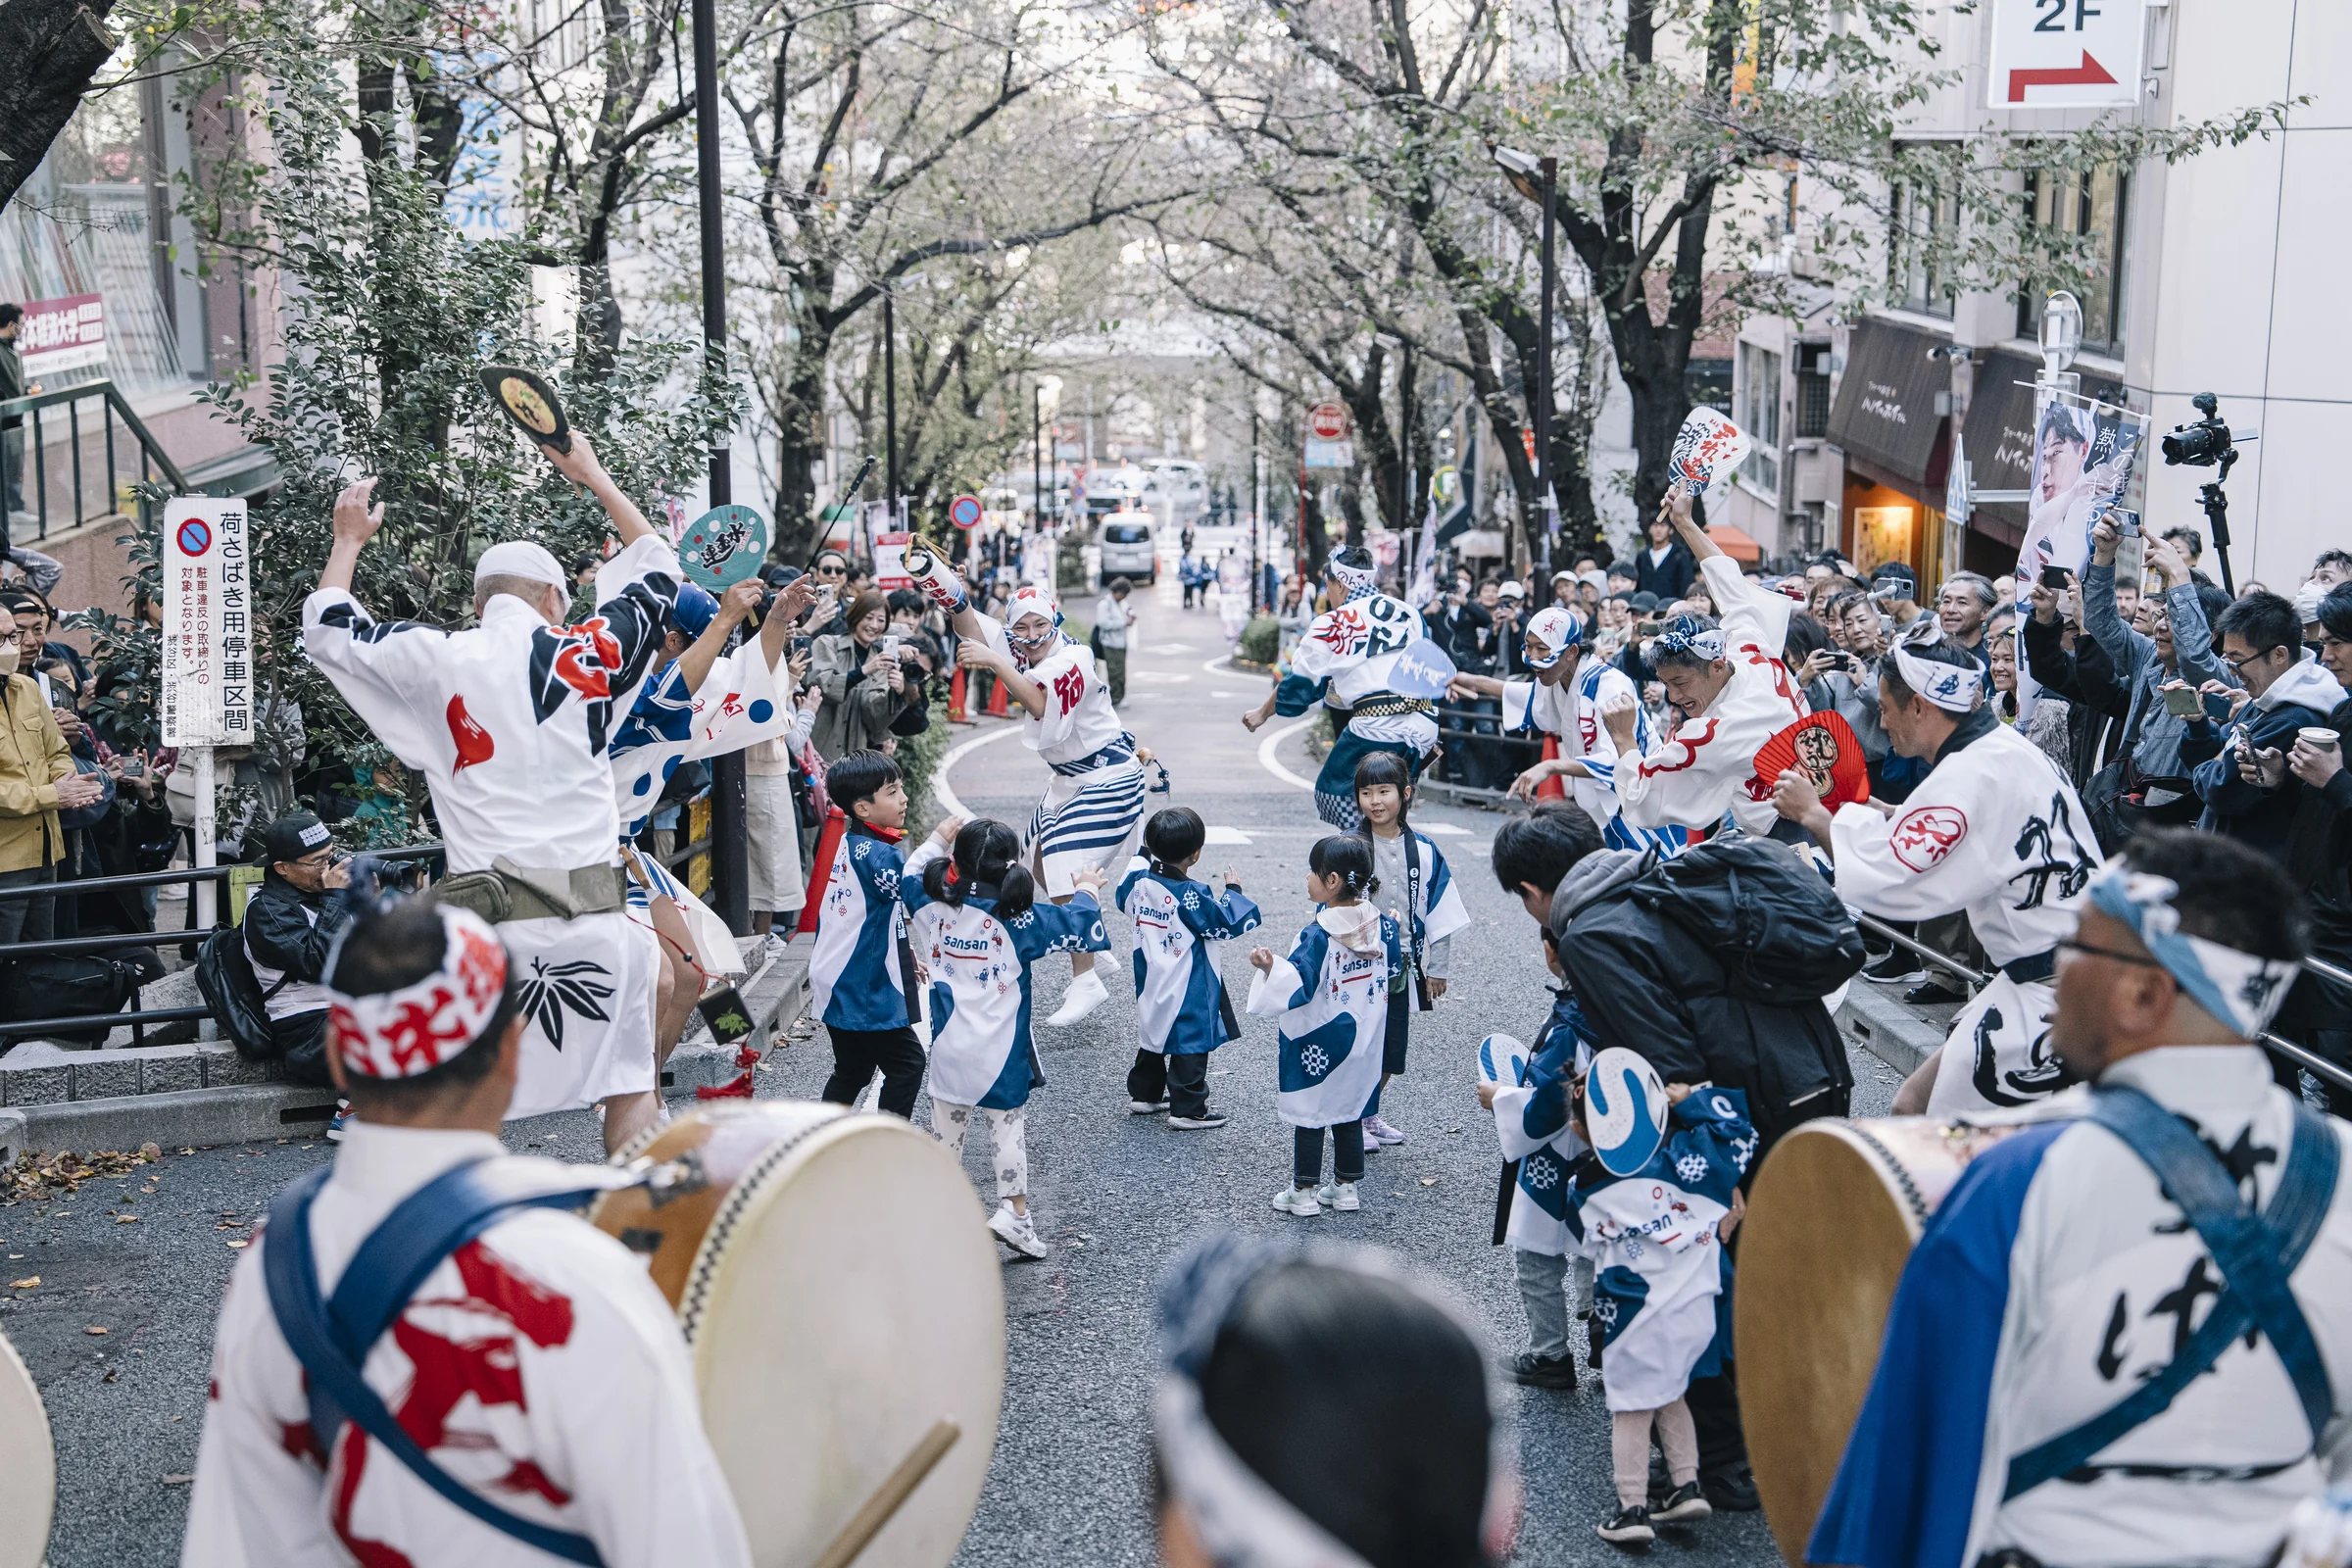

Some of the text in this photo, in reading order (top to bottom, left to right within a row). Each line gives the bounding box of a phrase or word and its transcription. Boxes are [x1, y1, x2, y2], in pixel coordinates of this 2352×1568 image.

[2034, 0, 2101, 31] 2F
[181, 566, 194, 665] 対象となります。
[196, 566, 209, 685] 駐車違反の取締りの
[220, 512, 247, 731] 荷さばき用停車区間
[166, 633, 177, 738] 渋谷区・渋谷警察署
[944, 935, 988, 951] sansan
[1139, 906, 1169, 921] sansan
